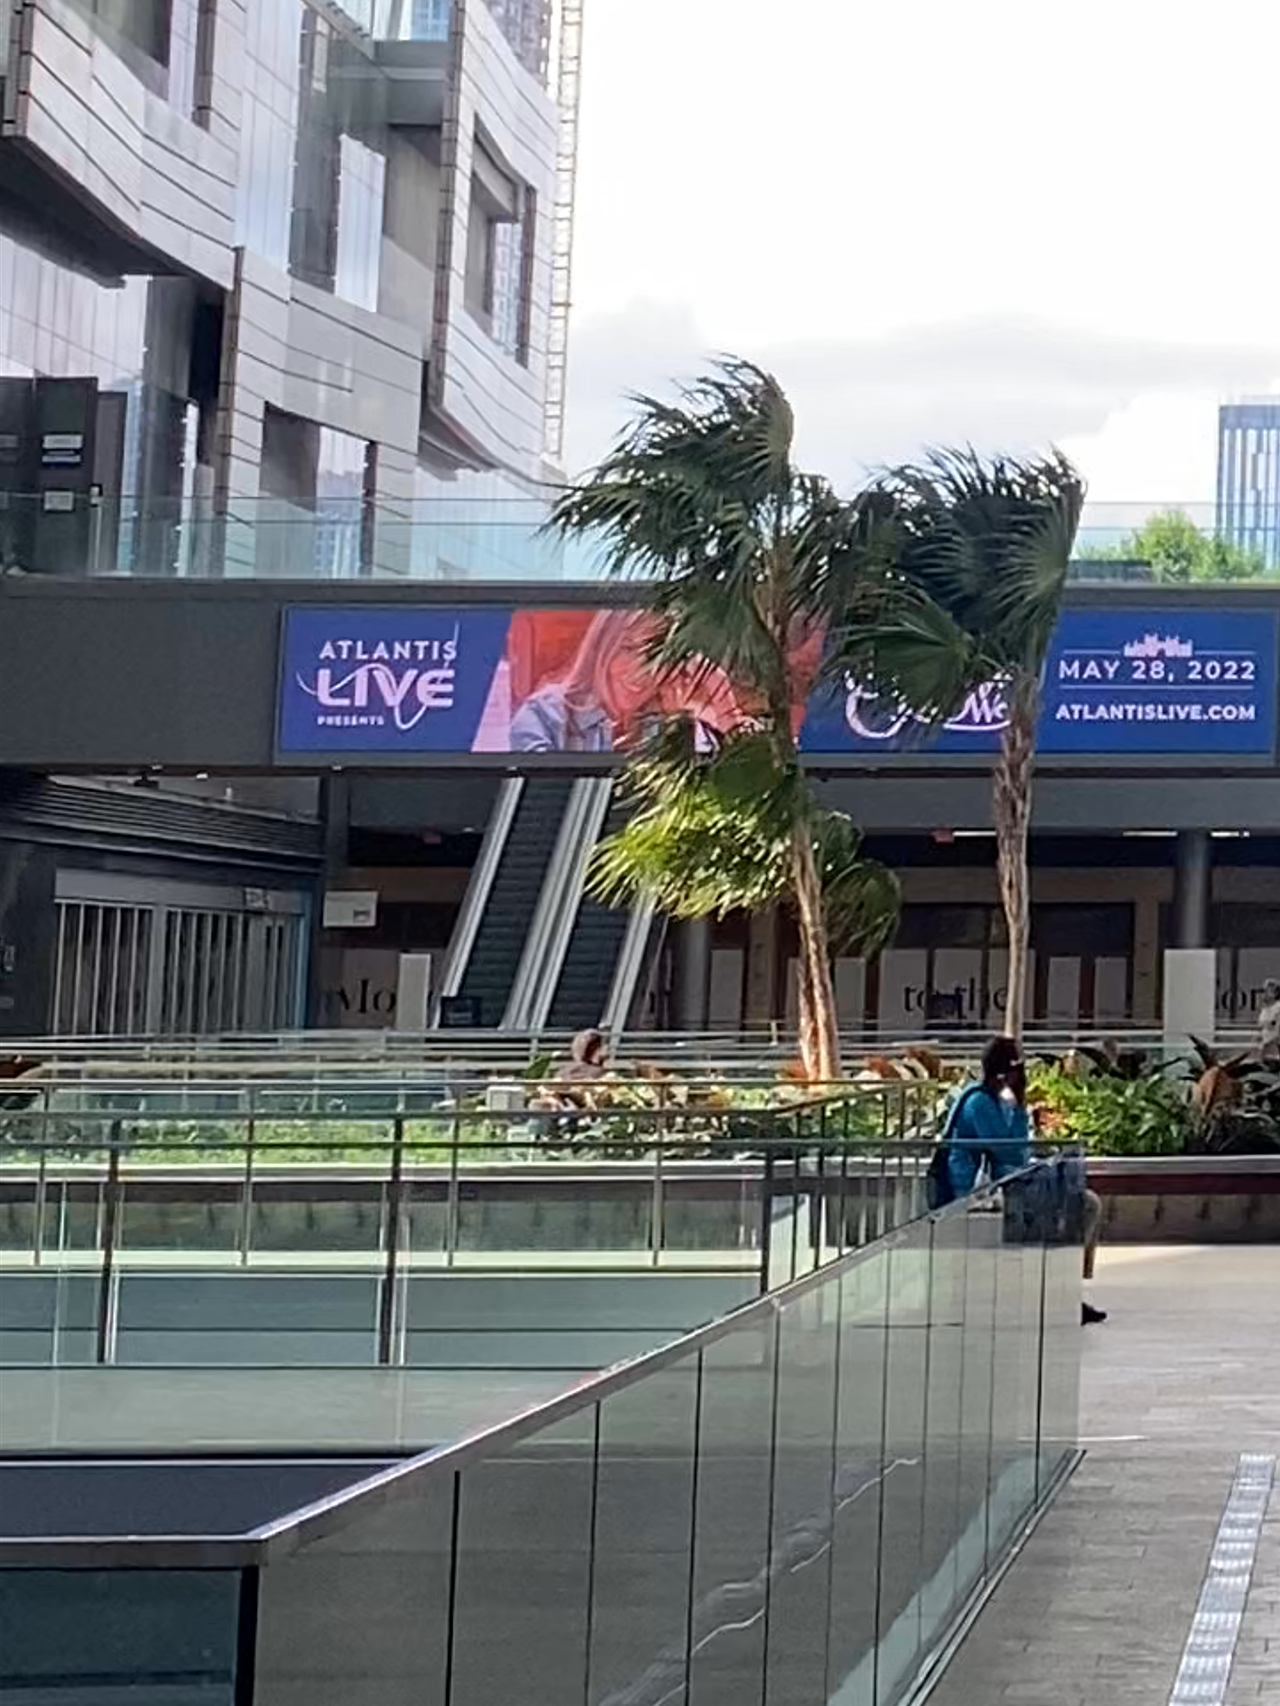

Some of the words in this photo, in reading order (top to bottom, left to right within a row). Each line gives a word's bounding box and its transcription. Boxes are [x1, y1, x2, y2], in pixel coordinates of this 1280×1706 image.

[318, 640, 457, 660] ATLANTIS
[1058, 659, 1120, 680] MAY
[1131, 660, 1174, 682] 28,
[1187, 661, 1255, 680] 2022
[317, 668, 455, 707] LIVE
[1055, 704, 1256, 721] ATLANTISLIVE.COM
